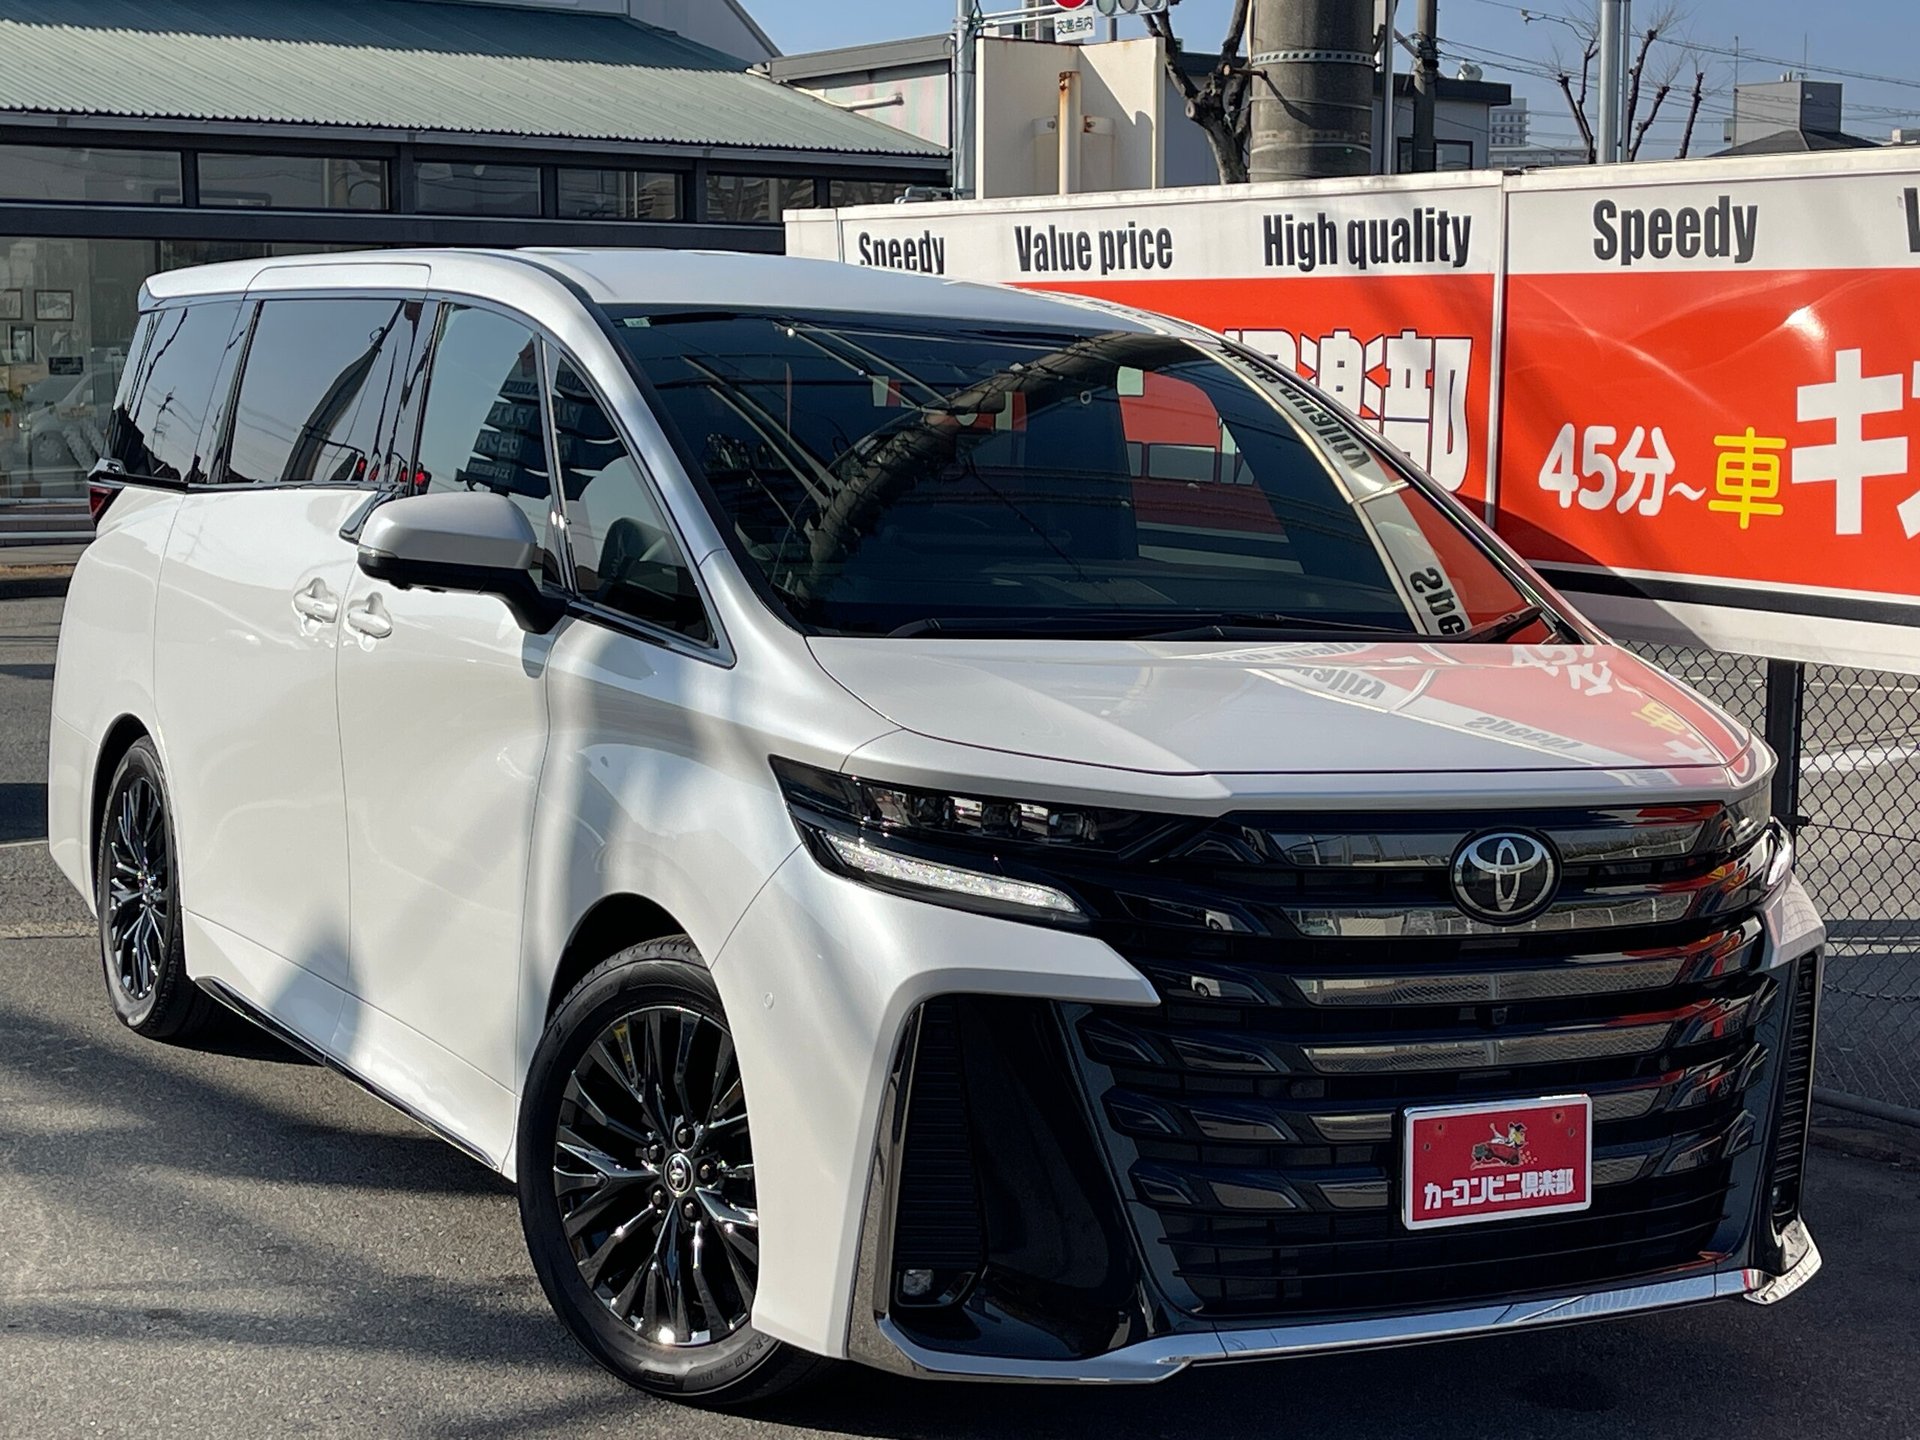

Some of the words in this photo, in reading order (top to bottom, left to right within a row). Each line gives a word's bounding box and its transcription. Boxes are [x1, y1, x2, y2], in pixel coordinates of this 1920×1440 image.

[1014, 225, 1092, 273] Value
[1098, 220, 1173, 276] price
[1263, 211, 1335, 272] High
[1346, 207, 1471, 271] quality
[1592, 195, 1759, 266] Speedy
[1424, 1168, 1574, 1210] カーコンビニ倶楽部
